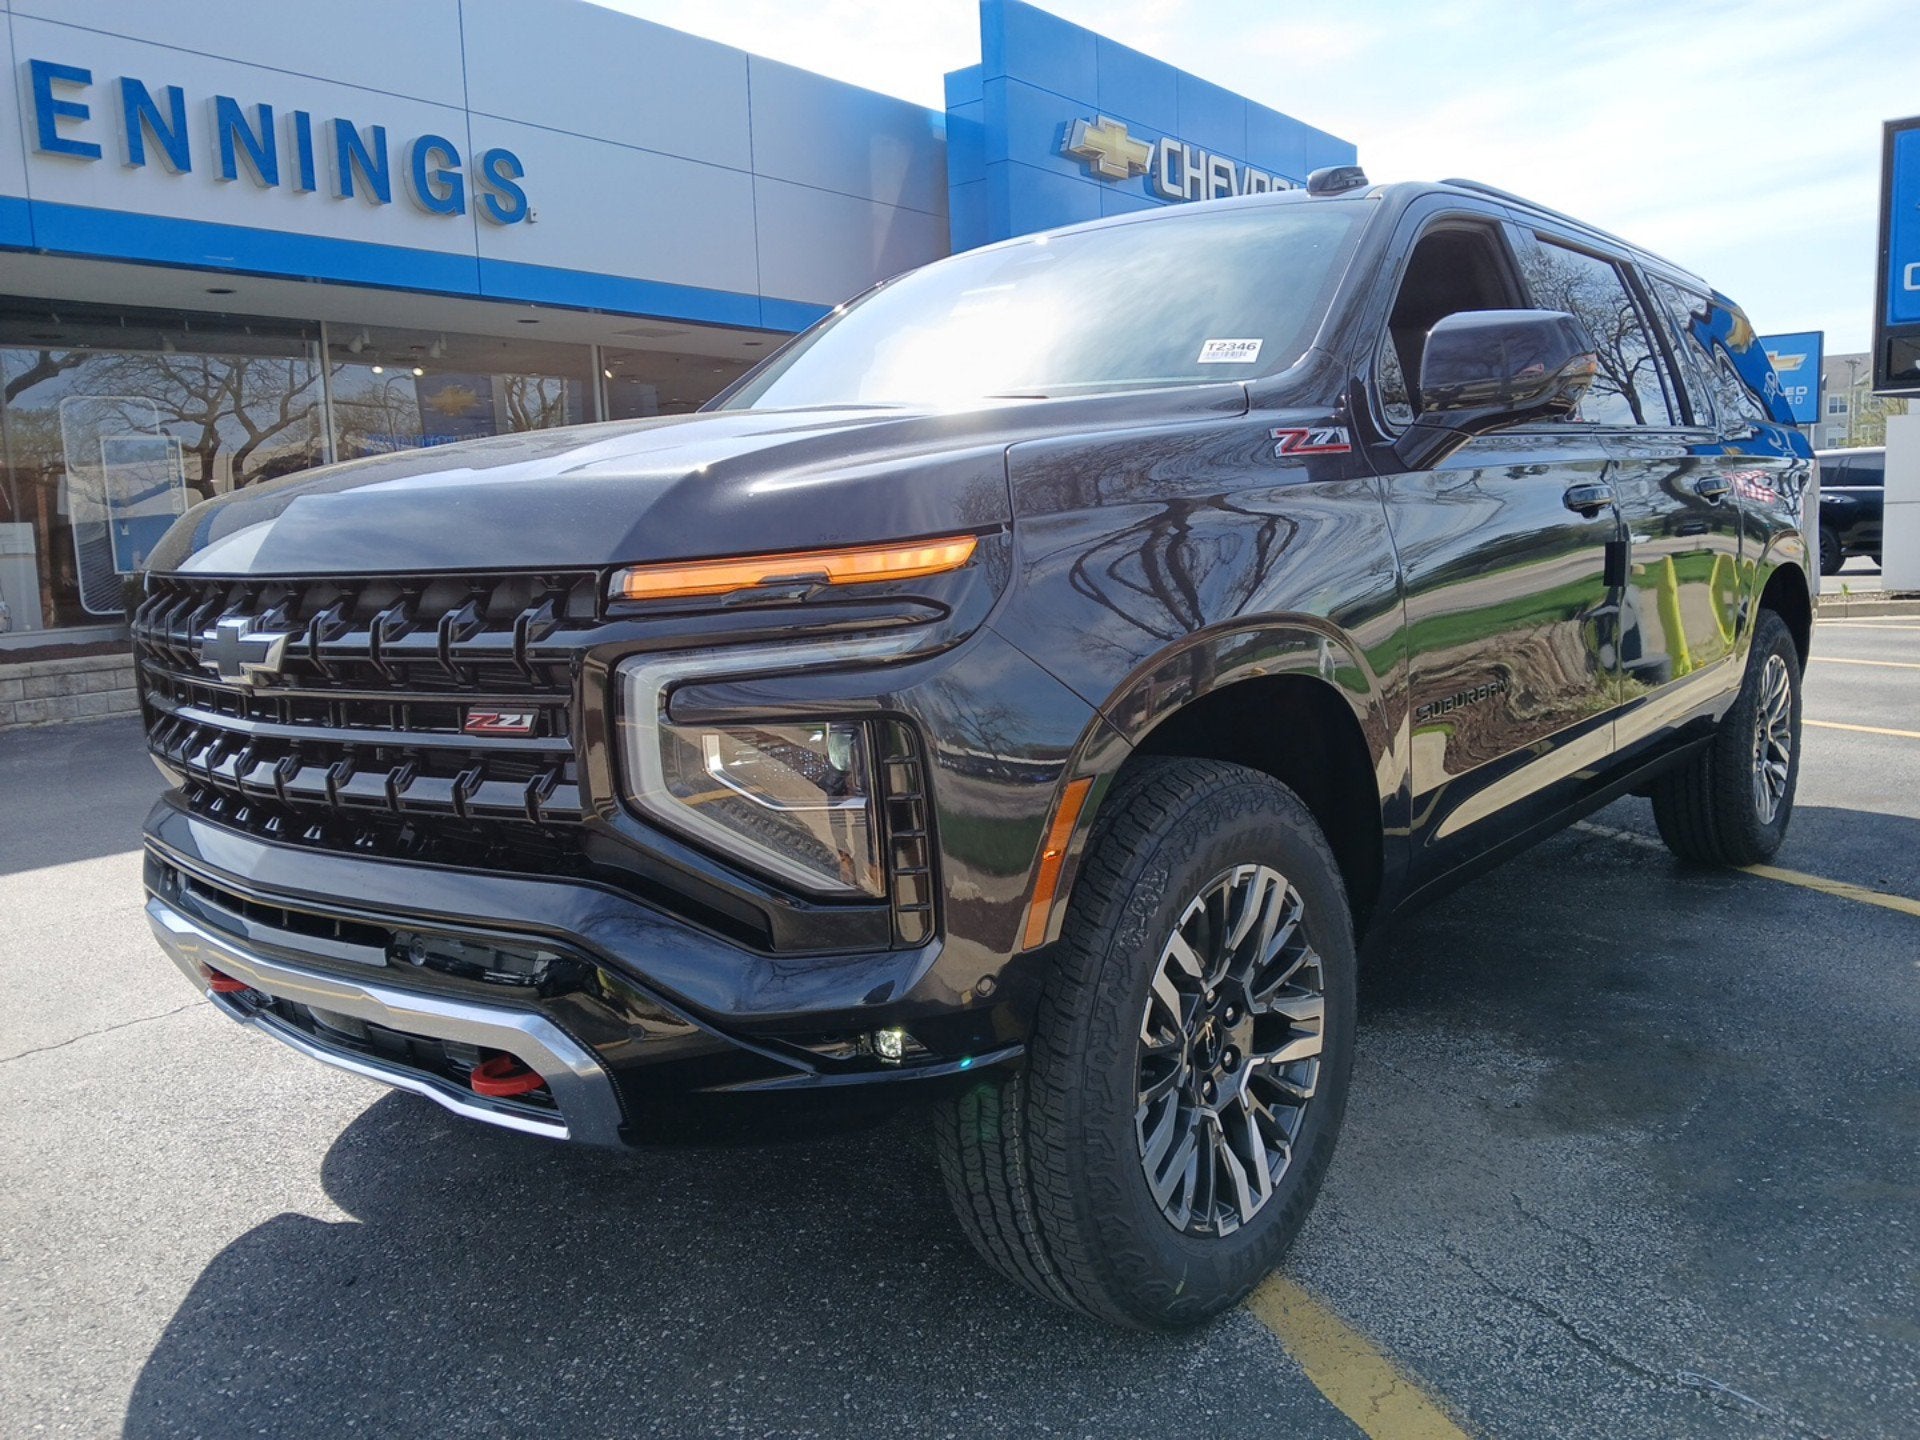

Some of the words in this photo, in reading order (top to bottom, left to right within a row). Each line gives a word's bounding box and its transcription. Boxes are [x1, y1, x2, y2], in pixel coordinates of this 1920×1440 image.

[1208, 341, 1258, 352] T2346
[1269, 426, 1352, 457] Z71
[1416, 679, 1509, 721] SUBURBAN
